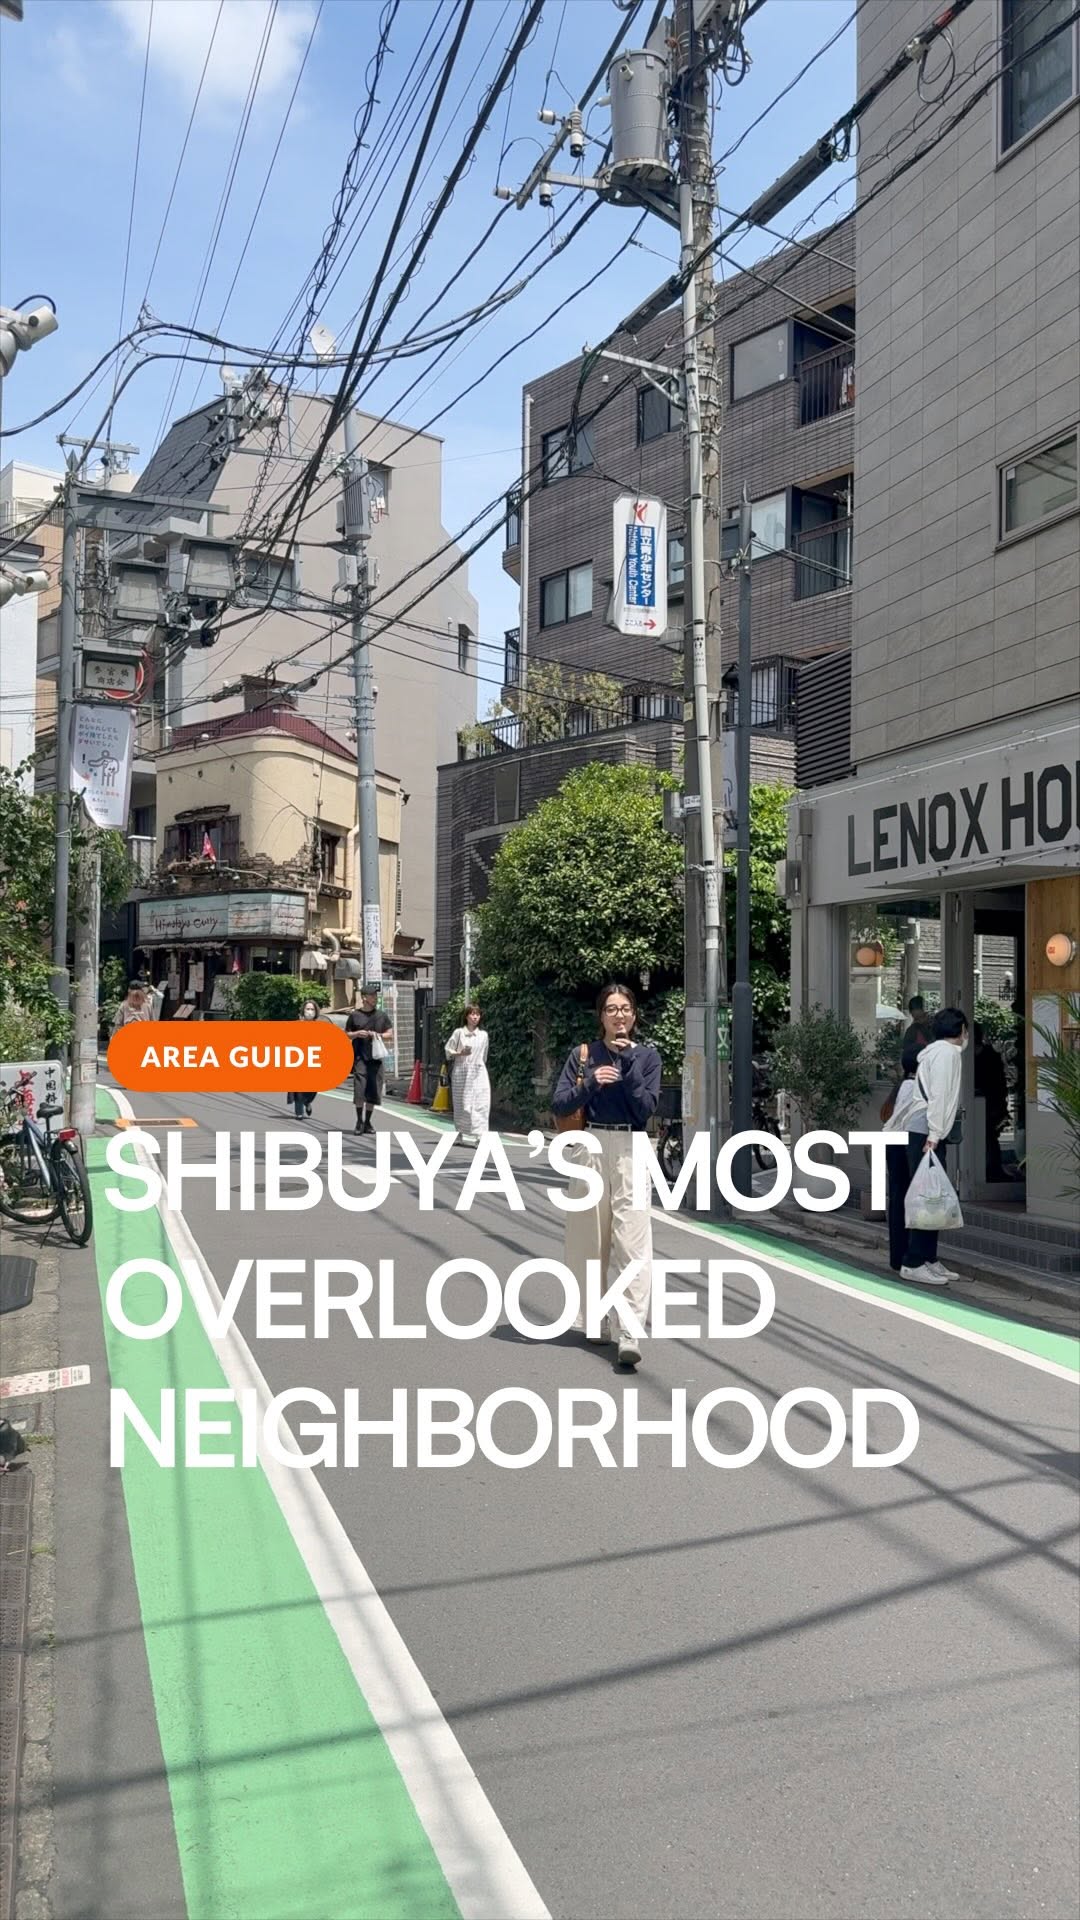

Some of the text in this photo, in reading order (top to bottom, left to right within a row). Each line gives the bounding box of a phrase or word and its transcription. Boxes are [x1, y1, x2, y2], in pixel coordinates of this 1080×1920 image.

[628, 525, 639, 604] National Youth Center
[639, 527, 652, 605] 国立青少年センター
[79, 723, 118, 734] おしゃれしても
[847, 760, 1080, 877] LENOX HO
[44, 1066, 58, 1104] 中国料
